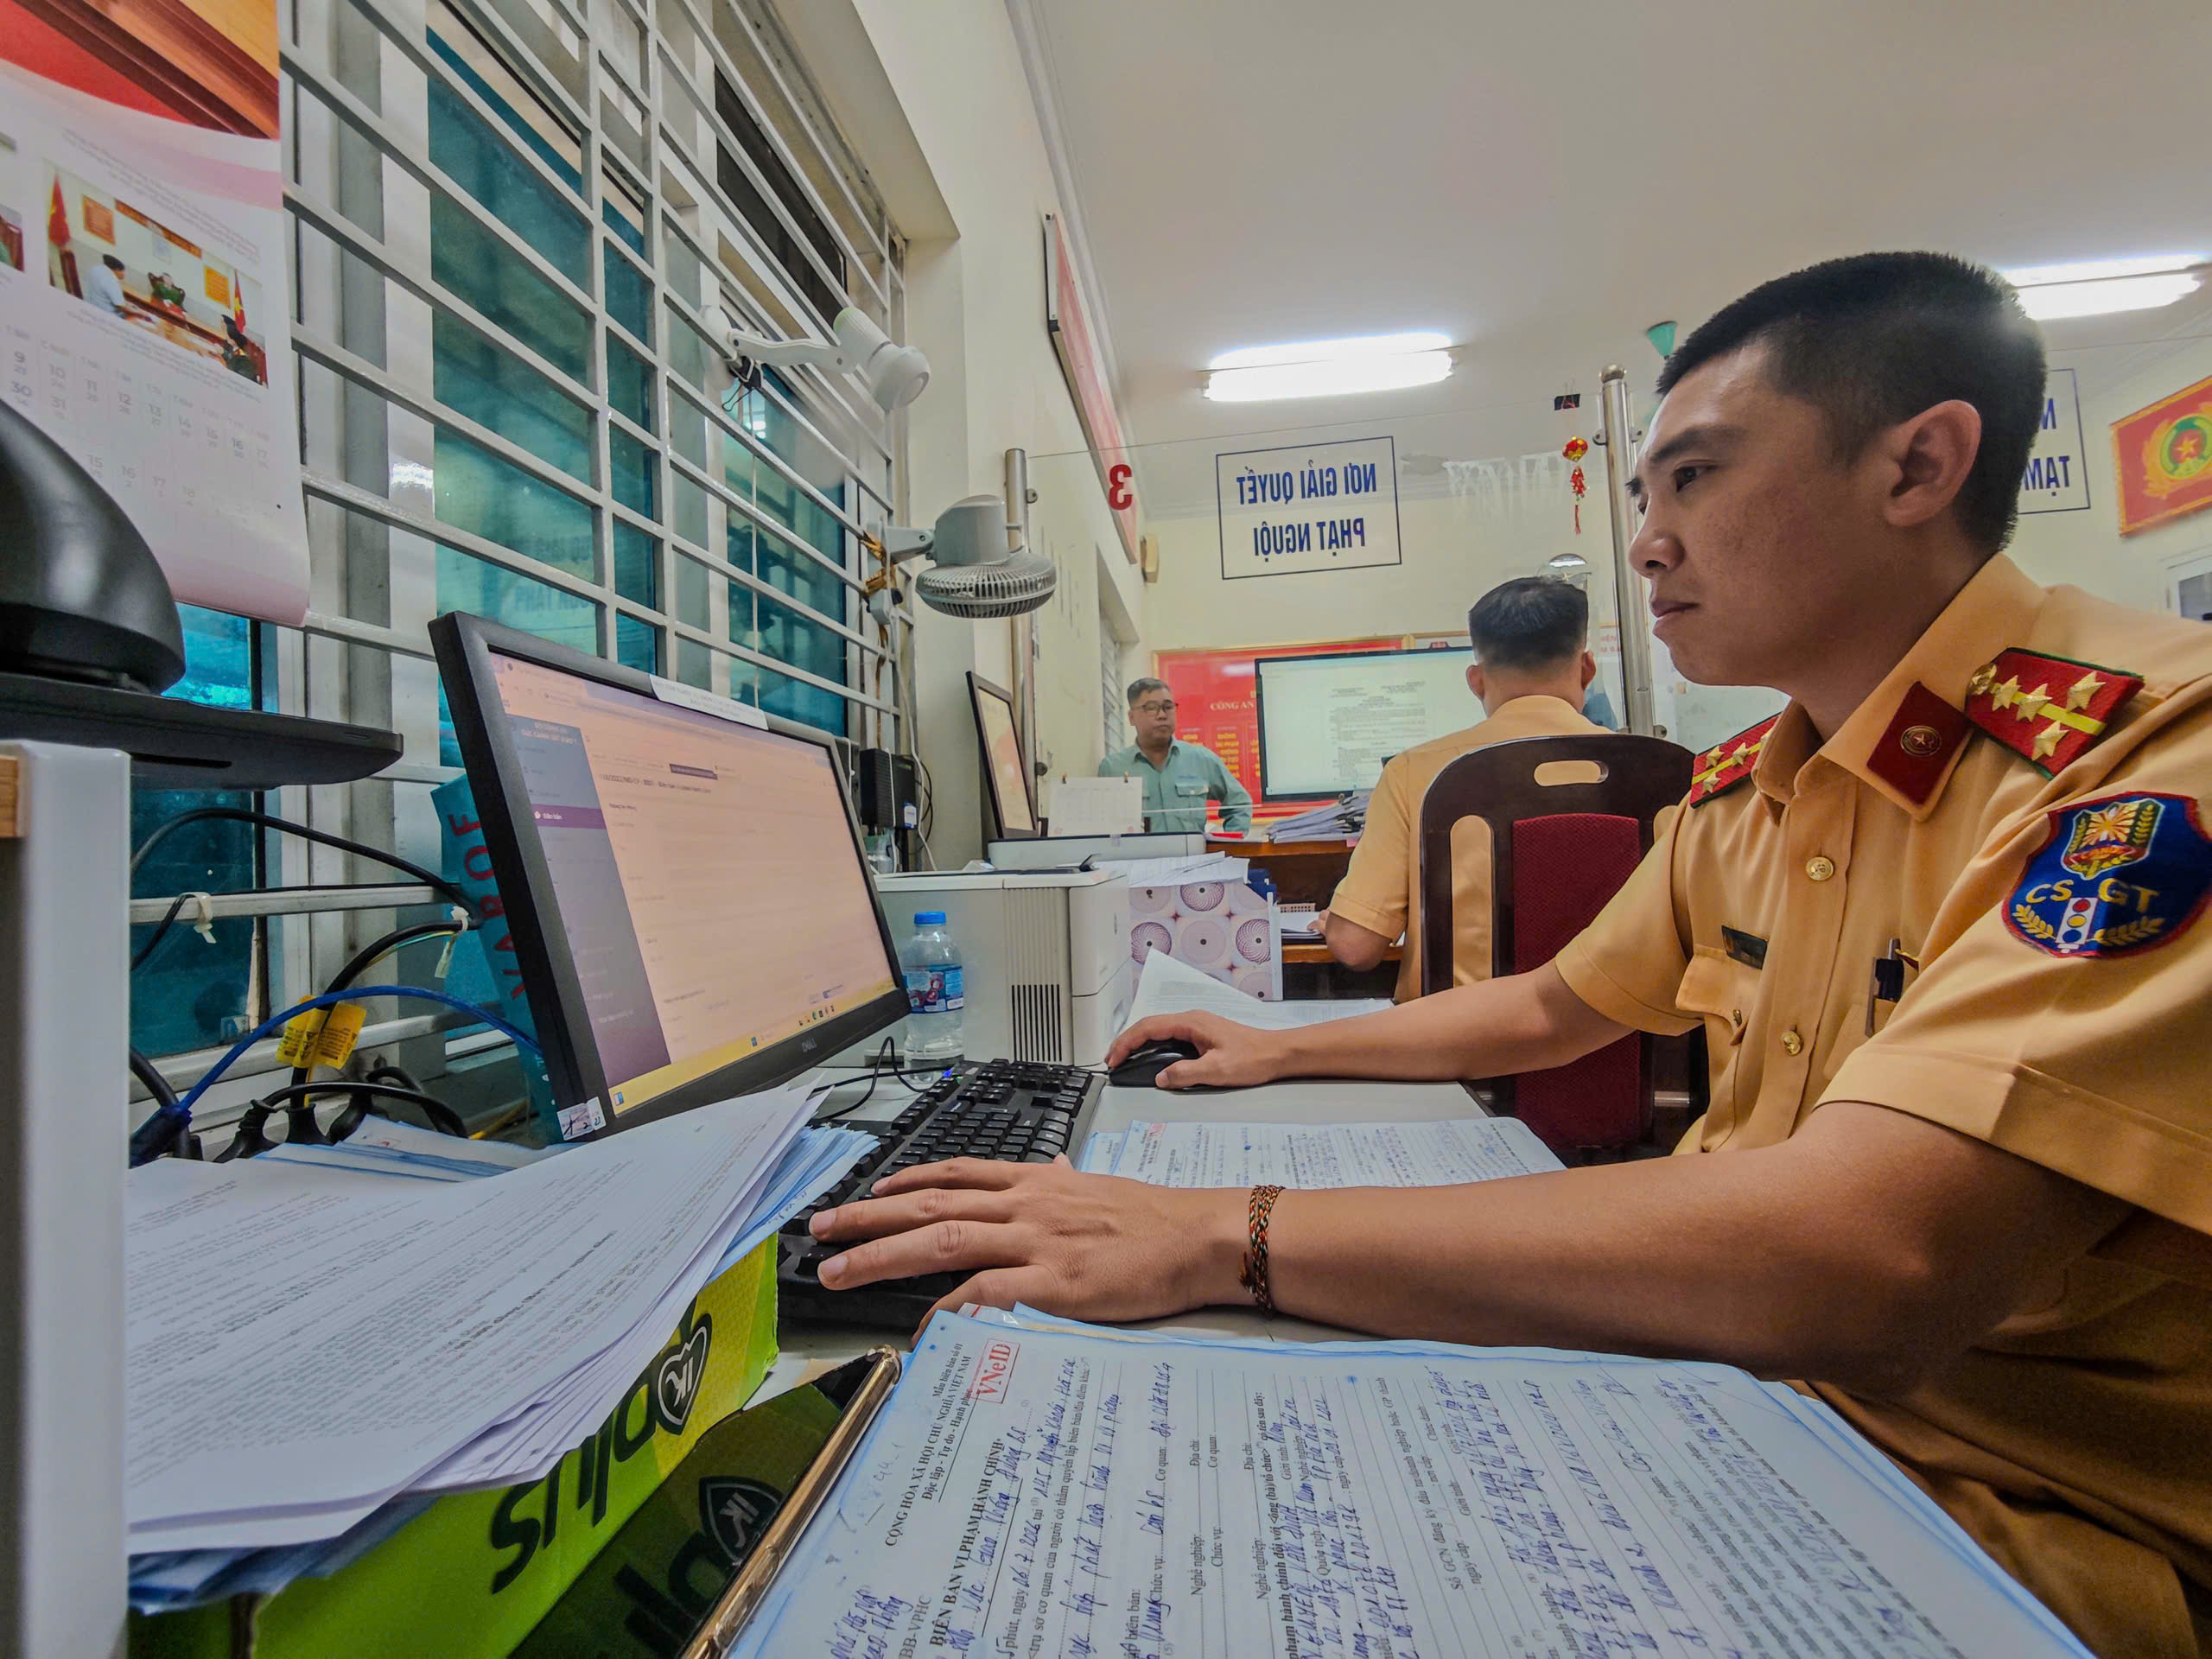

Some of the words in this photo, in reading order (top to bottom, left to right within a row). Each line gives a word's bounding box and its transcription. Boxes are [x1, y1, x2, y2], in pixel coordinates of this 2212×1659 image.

[2026, 879, 2075, 905] CS
[2099, 877, 2159, 914] GT
[954, 1355, 971, 1373] NAM
[976, 1343, 1012, 1396] VNeID
[947, 1374, 966, 1392] VIỆT
[935, 1392, 958, 1421] NGHĨA
[1254, 1392, 1263, 1406] đây:
[950, 1407, 969, 1427] Hạnh
[1256, 1408, 1265, 1419] sau
[925, 1423, 943, 1444] CHỦ
[1067, 1427, 1081, 1443] biên
[1256, 1421, 1266, 1432] tên
[943, 1433, 956, 1445] do
[1189, 1438, 1200, 1452] chỉ:
[1207, 1434, 1219, 1454] quan:
[1243, 1442, 1253, 1455] chỉ:
[919, 1446, 938, 1465] HỘI
[938, 1446, 952, 1458] Tự
[1064, 1445, 1079, 1457] lập
[1157, 1446, 1168, 1466] quan:
[1189, 1452, 1202, 1467] Địa
[1279, 1445, 1287, 1461] tính:
[1058, 1459, 1077, 1483] quyền
[1209, 1456, 1218, 1468] Cơ
[1243, 1456, 1254, 1470] Địa
[1281, 1463, 1293, 1480] Giới
[908, 1466, 926, 1481] XÃ
[928, 1466, 945, 1484] lập
[1156, 1468, 1167, 1481] Cơ
[899, 1484, 920, 1509] HÒA
[921, 1484, 940, 1500] Độc
[971, 1479, 993, 1512] HÀNH
[1054, 1485, 1071, 1506] thẩm
[1030, 1509, 1044, 1521] tại
[1052, 1509, 1065, 1520] có
[1268, 1503, 1279, 1523] <ông
[1459, 1497, 1472, 1516] Giới
[885, 1511, 908, 1547] CỘNG
[959, 1515, 981, 1554] PHẠM
[1048, 1522, 1064, 1548] người
[1211, 1527, 1224, 1540] vụ:
[1269, 1527, 1281, 1541] với
[1311, 1528, 1324, 1548] tịch:
[1431, 1522, 1446, 1543] đăng
[1045, 1552, 1058, 1568] của
[1190, 1535, 1205, 1567] nghiệp:
[1211, 1542, 1224, 1567] Chức
[1253, 1537, 1267, 1571] nghiệp:
[1271, 1543, 1285, 1559] đối
[1439, 1548, 1457, 1573] GCN
[953, 1554, 967, 1569] VI
[1152, 1555, 1163, 1570] vụ:
[1316, 1550, 1330, 1575] Quốc
[1039, 1572, 1055, 1598] quan
[1186, 1569, 1206, 1595] Nghề
[1251, 1573, 1268, 1599] Nghề
[1275, 1562, 1289, 1590] chính
[1448, 1576, 1464, 1590] Số
[943, 1575, 963, 1604] BẢN
[1149, 1574, 1163, 1602] Chức
[1010, 1589, 1029, 1615] ngày
[1036, 1600, 1048, 1614] cơ
[1126, 1590, 1141, 1611] bản:
[1280, 1593, 1294, 1622] hành
[929, 1610, 952, 1646] BIÊN
[1030, 1616, 1046, 1630] sở
[1125, 1616, 1138, 1640] biên
[1002, 1618, 1020, 1649] phút,
